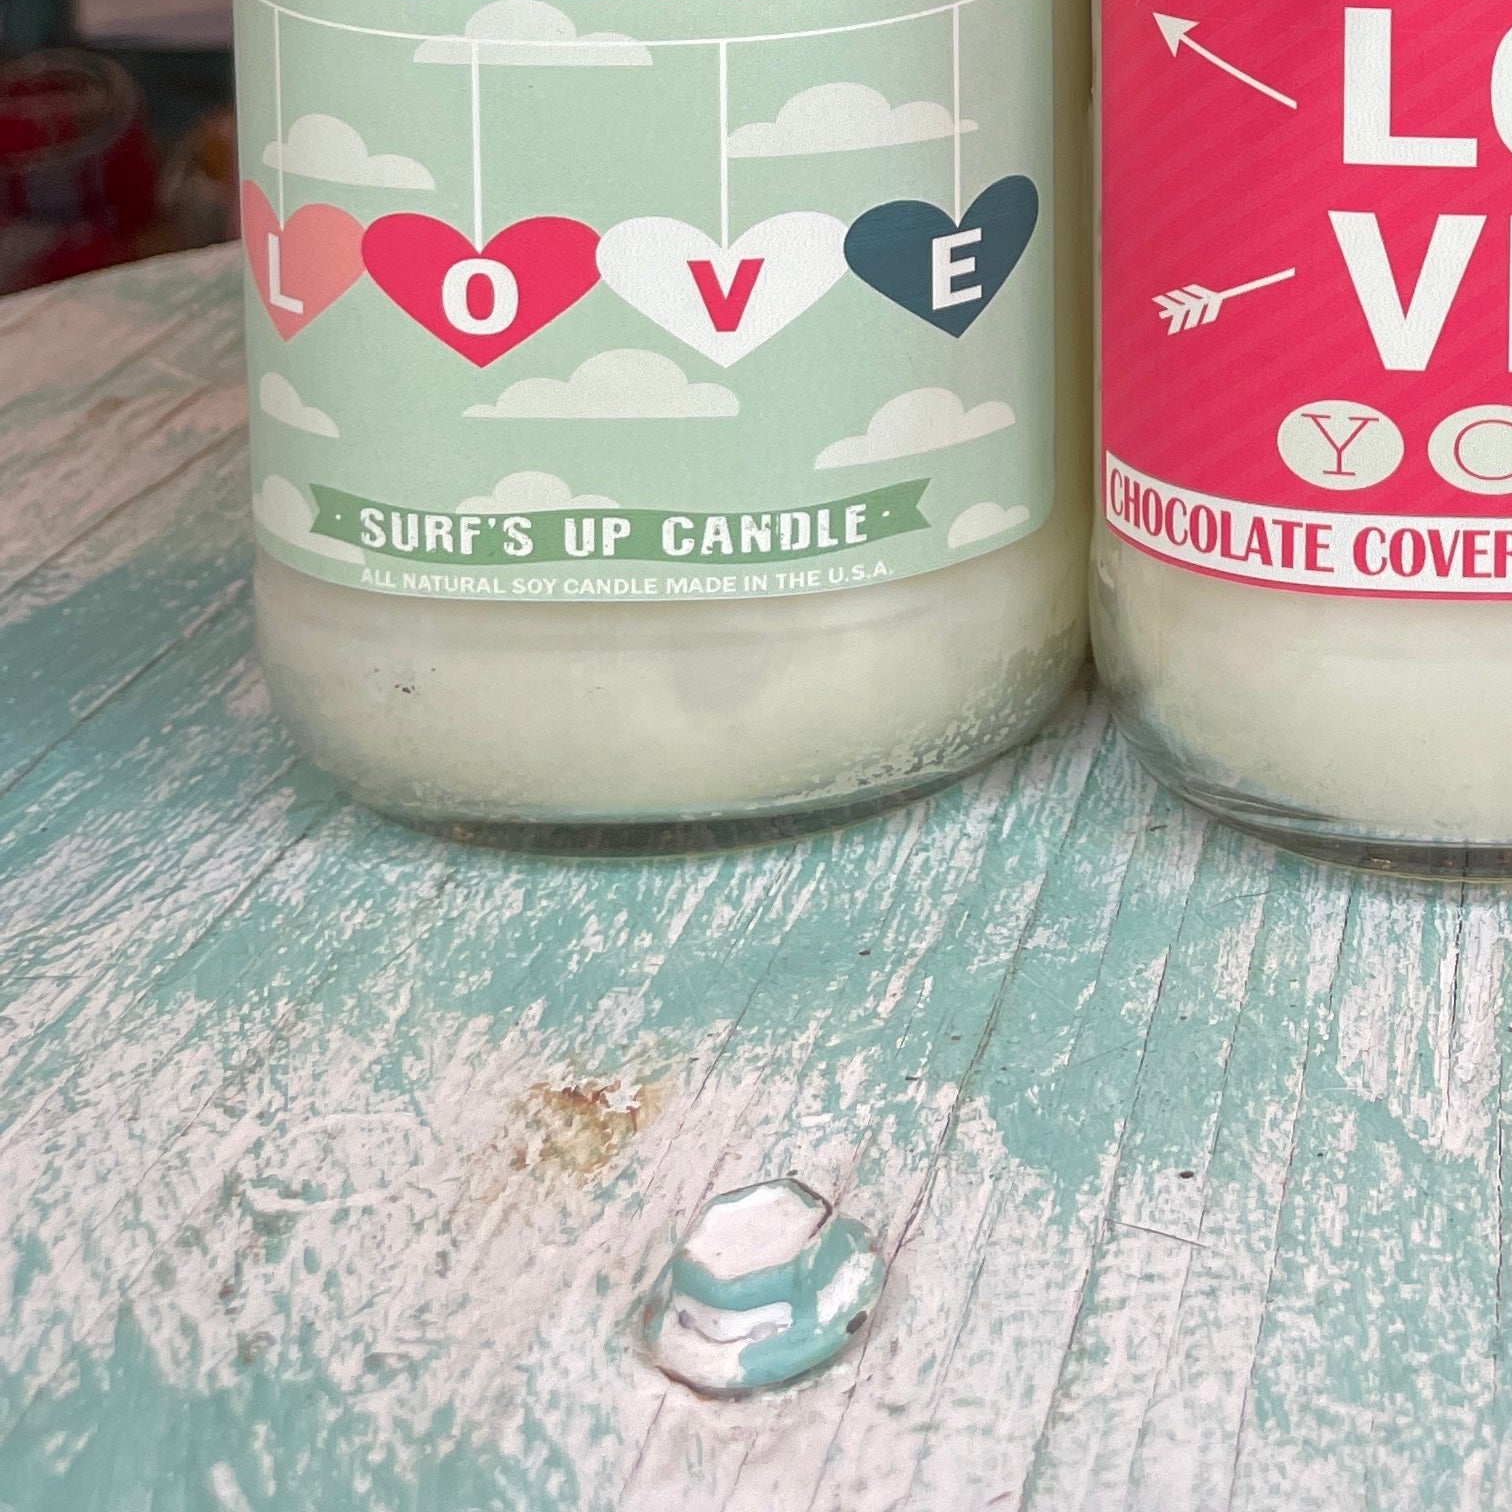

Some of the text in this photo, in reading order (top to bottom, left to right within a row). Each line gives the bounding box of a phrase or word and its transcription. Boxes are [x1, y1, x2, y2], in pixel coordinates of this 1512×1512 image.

[360, 504, 868, 558] SURF'S UP CANDLE
[1108, 467, 1334, 575] CHOCOLATE
[360, 560, 895, 596] ALL NATURAL SOY CANDLE MADE IN THE U.S.A.
